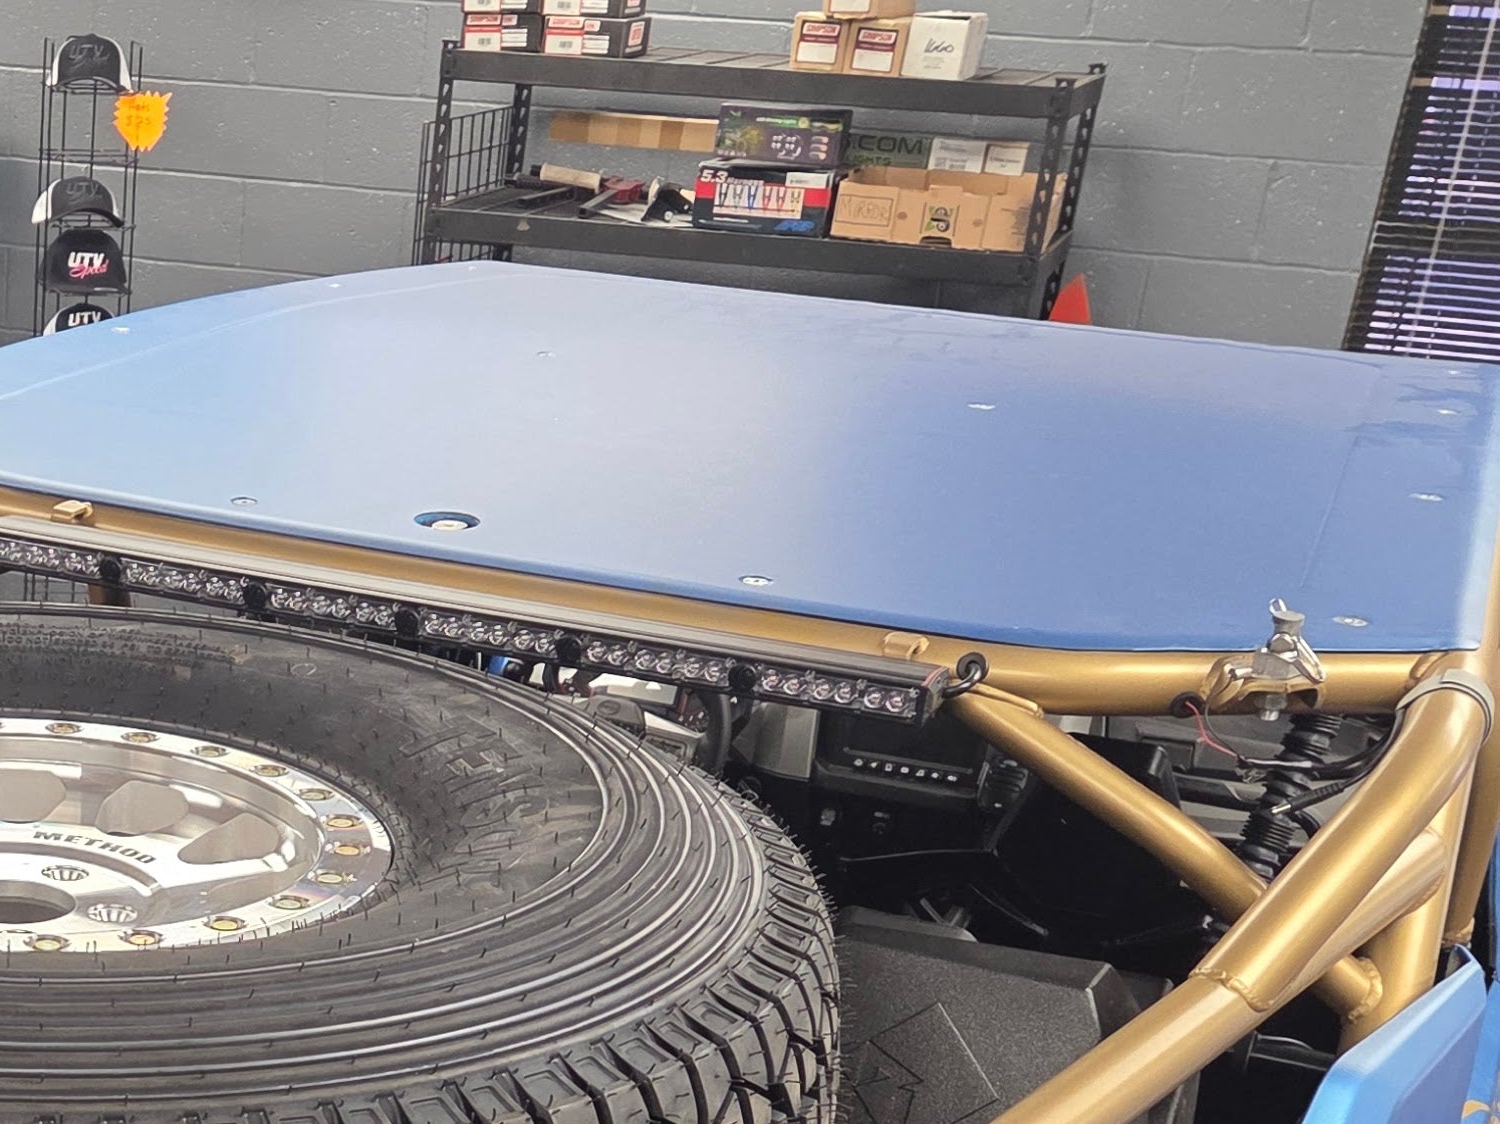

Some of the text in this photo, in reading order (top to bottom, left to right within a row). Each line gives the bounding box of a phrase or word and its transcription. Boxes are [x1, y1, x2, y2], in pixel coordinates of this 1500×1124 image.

[700, 169, 729, 183] 5.3
[67, 251, 105, 268] UTV
[67, 311, 102, 327] UTV
[33, 830, 157, 865] METHOD
